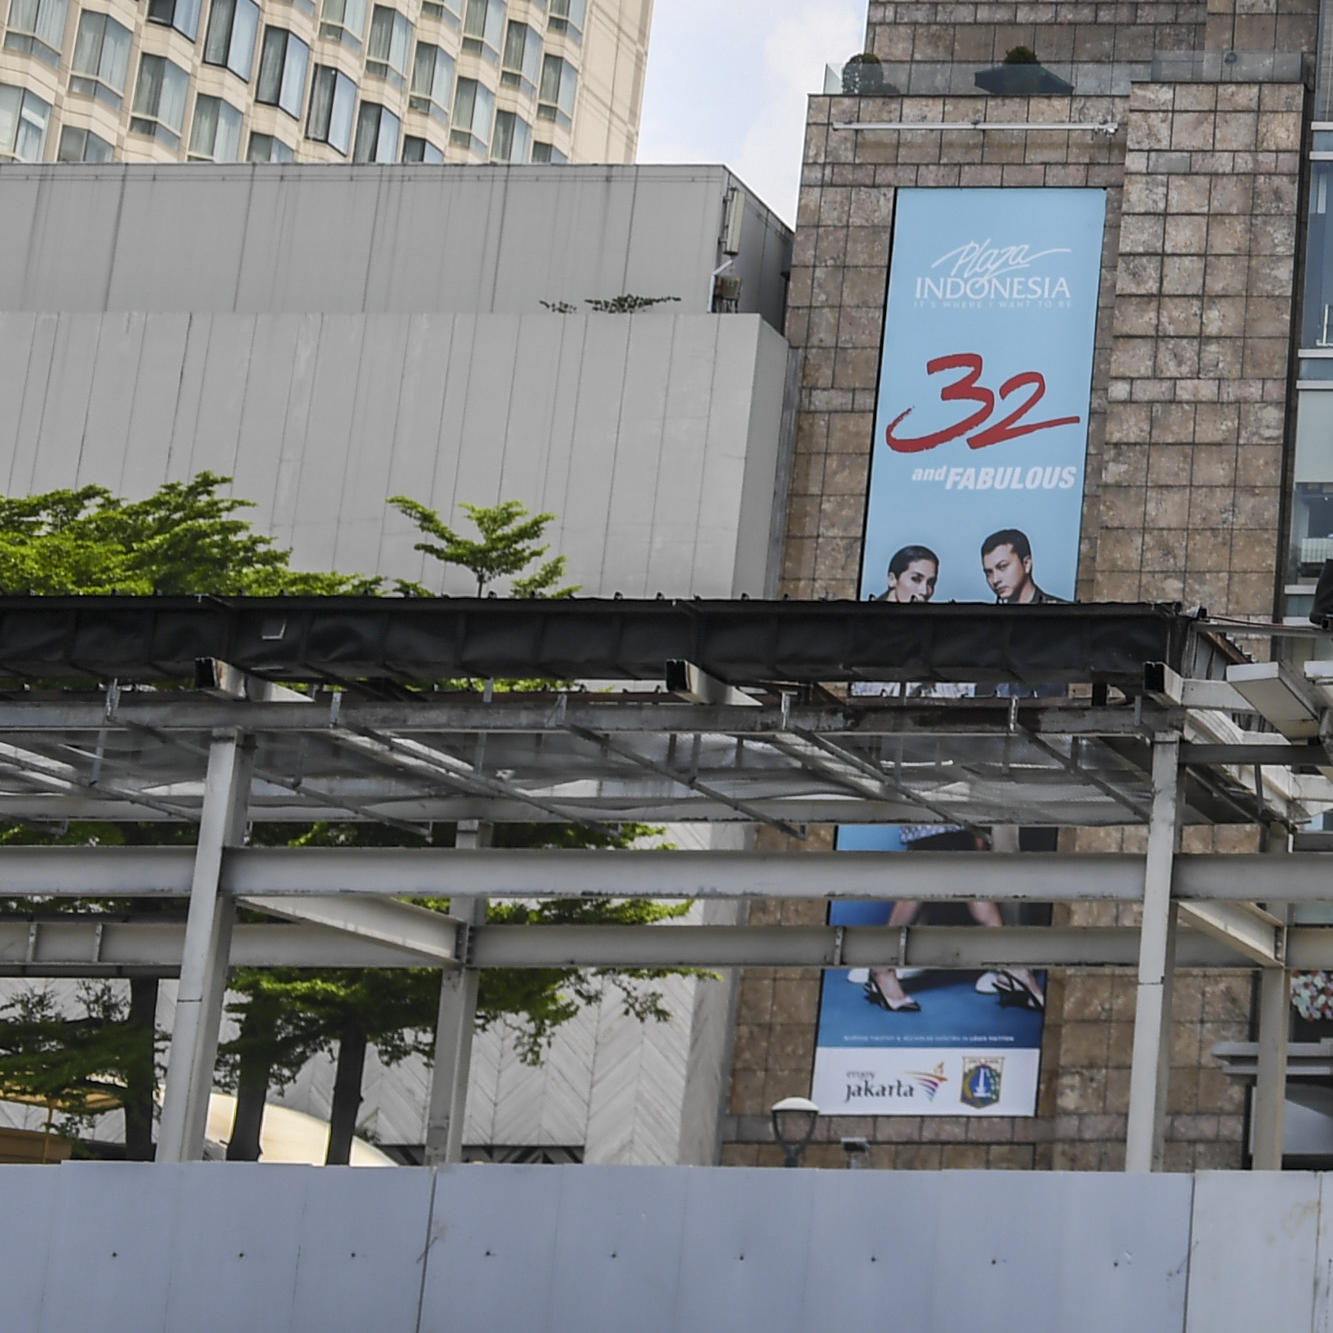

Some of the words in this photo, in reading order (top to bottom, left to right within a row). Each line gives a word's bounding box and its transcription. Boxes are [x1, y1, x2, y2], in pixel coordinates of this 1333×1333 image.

[931, 238, 1072, 288] Plaza
[915, 277, 1072, 299] INDONESIA
[886, 352, 1081, 454] 32
[911, 466, 948, 482] and
[945, 466, 1077, 490] FABULOUS
[844, 1079, 915, 1104] jakarta
